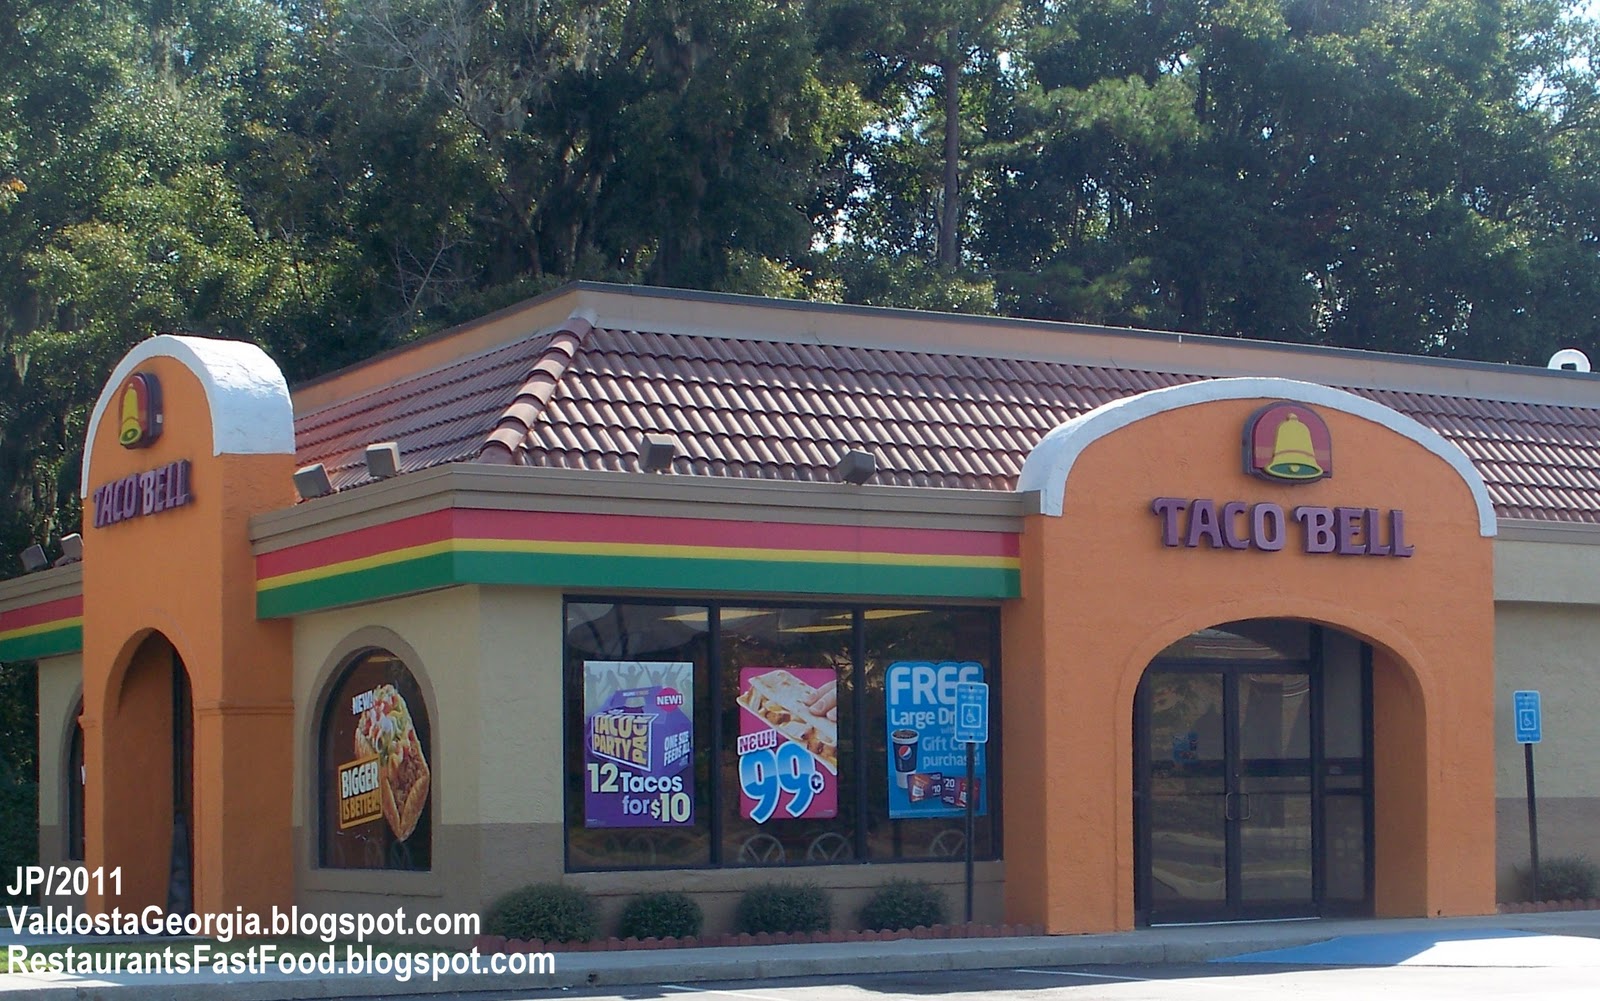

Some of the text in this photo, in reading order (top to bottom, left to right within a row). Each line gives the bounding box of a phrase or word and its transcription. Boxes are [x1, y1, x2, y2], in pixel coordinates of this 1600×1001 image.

[93, 459, 190, 529] TACO BELL
[1152, 496, 1415, 558] TACO BELL
[656, 694, 682, 705] NEW!
[594, 714, 635, 738] TACO
[891, 708, 936, 729] Large
[594, 733, 632, 761] PARTY
[664, 733, 679, 751] ONE
[922, 736, 980, 751] Gift Ca
[341, 761, 379, 799] BIGGER
[587, 763, 683, 793] 12 Tacos
[342, 798, 351, 821] IS
[622, 792, 691, 823] for $10
